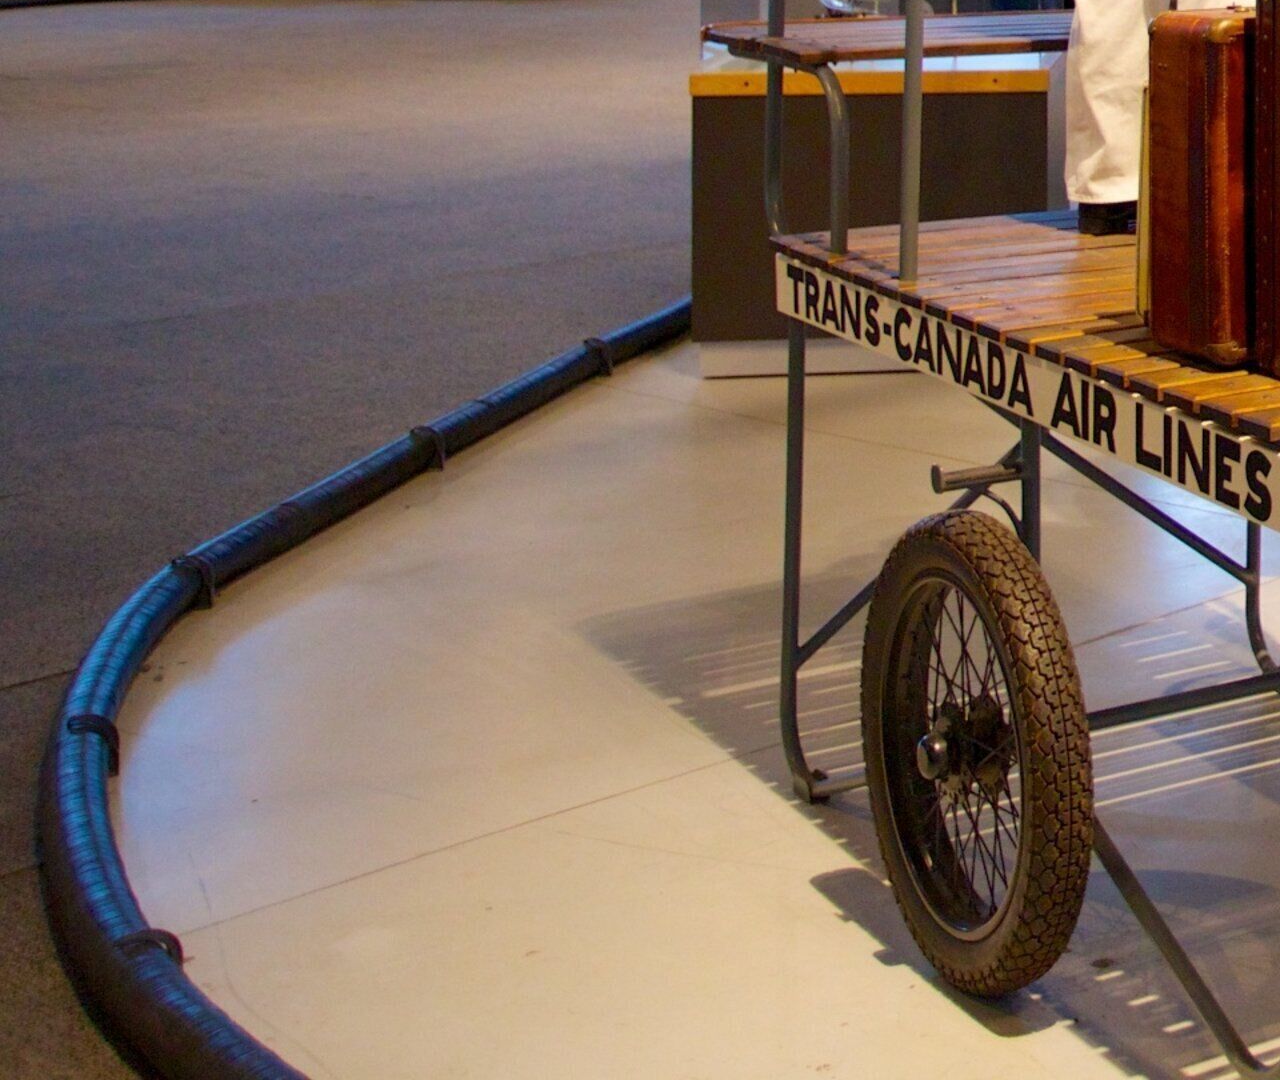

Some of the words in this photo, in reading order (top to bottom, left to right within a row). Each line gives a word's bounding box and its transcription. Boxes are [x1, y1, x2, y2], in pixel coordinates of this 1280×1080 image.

[787, 263, 1033, 417] TRANS-CANADA
[1050, 369, 1118, 454] AIR
[1135, 400, 1273, 523] LINES
